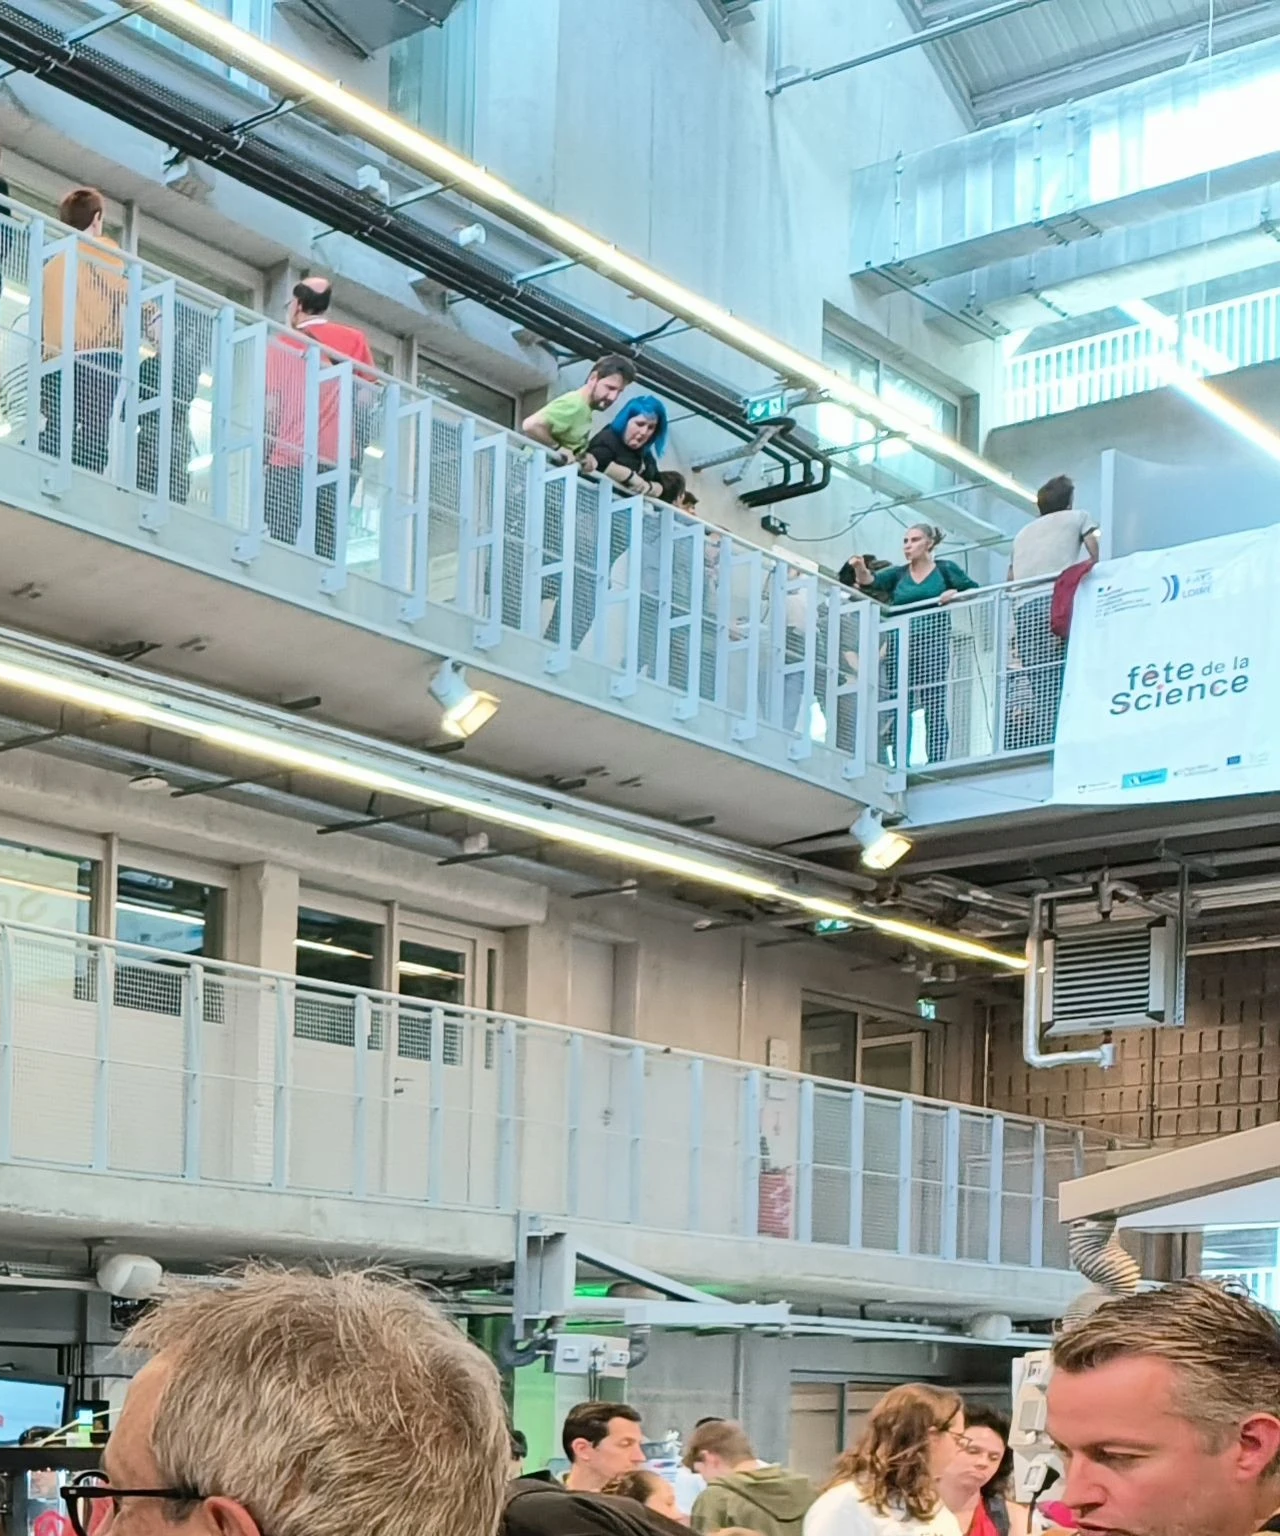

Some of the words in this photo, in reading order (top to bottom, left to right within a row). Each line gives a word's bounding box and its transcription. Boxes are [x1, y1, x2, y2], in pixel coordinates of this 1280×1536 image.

[1128, 661, 1194, 690] fête
[1202, 662, 1225, 676] de
[1233, 656, 1249, 670] la
[1110, 674, 1248, 715] Science
